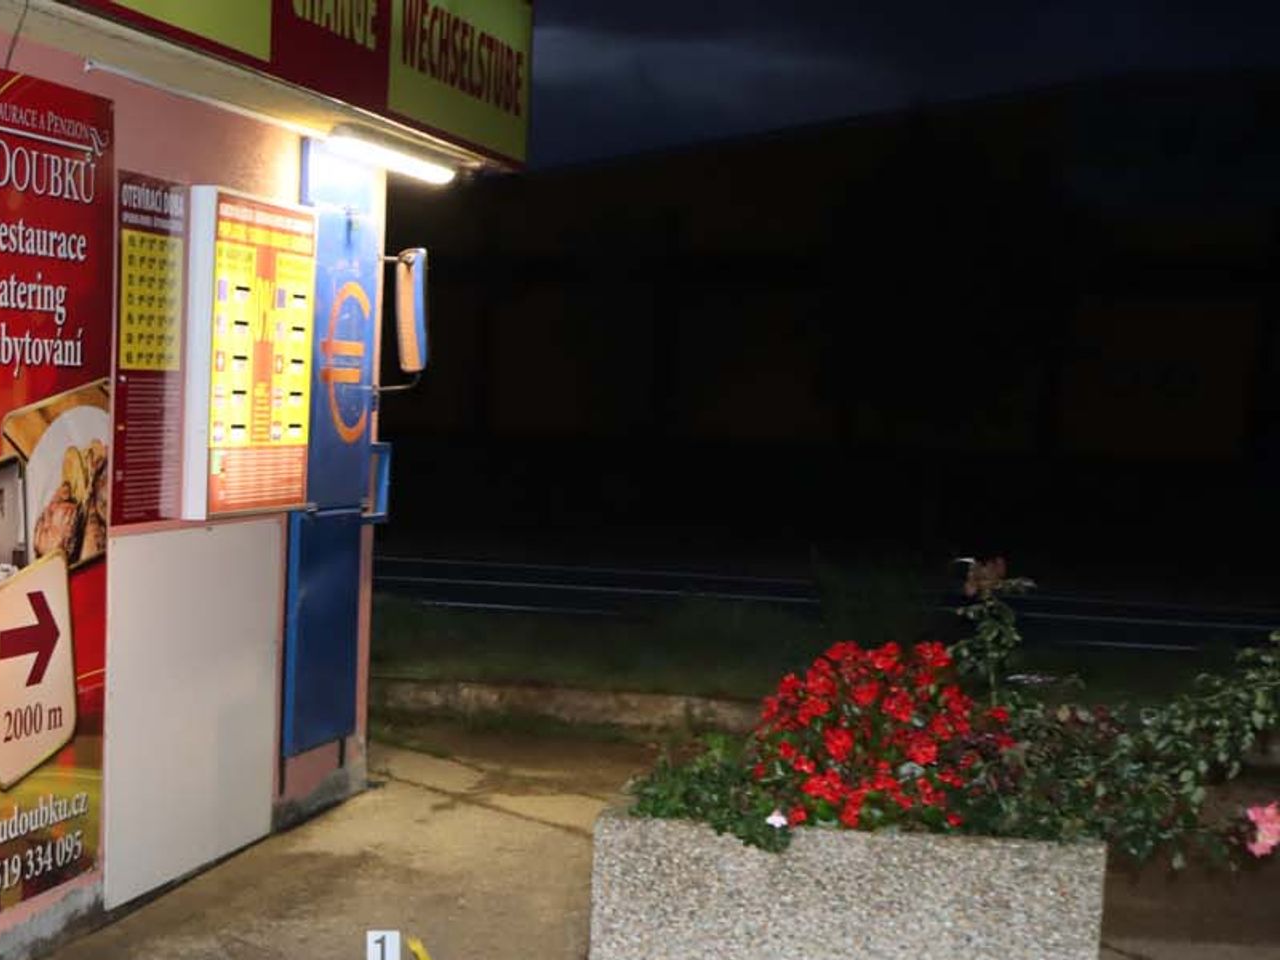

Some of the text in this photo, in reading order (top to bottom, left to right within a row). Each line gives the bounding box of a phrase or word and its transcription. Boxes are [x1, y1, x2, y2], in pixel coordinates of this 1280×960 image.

[402, 0, 523, 116] WECHSELSTUBE
[47, 112, 89, 138] PENZION
[3, 703, 63, 744] 2000 m
[24, 841, 53, 880] 334
[55, 830, 83, 868] 095
